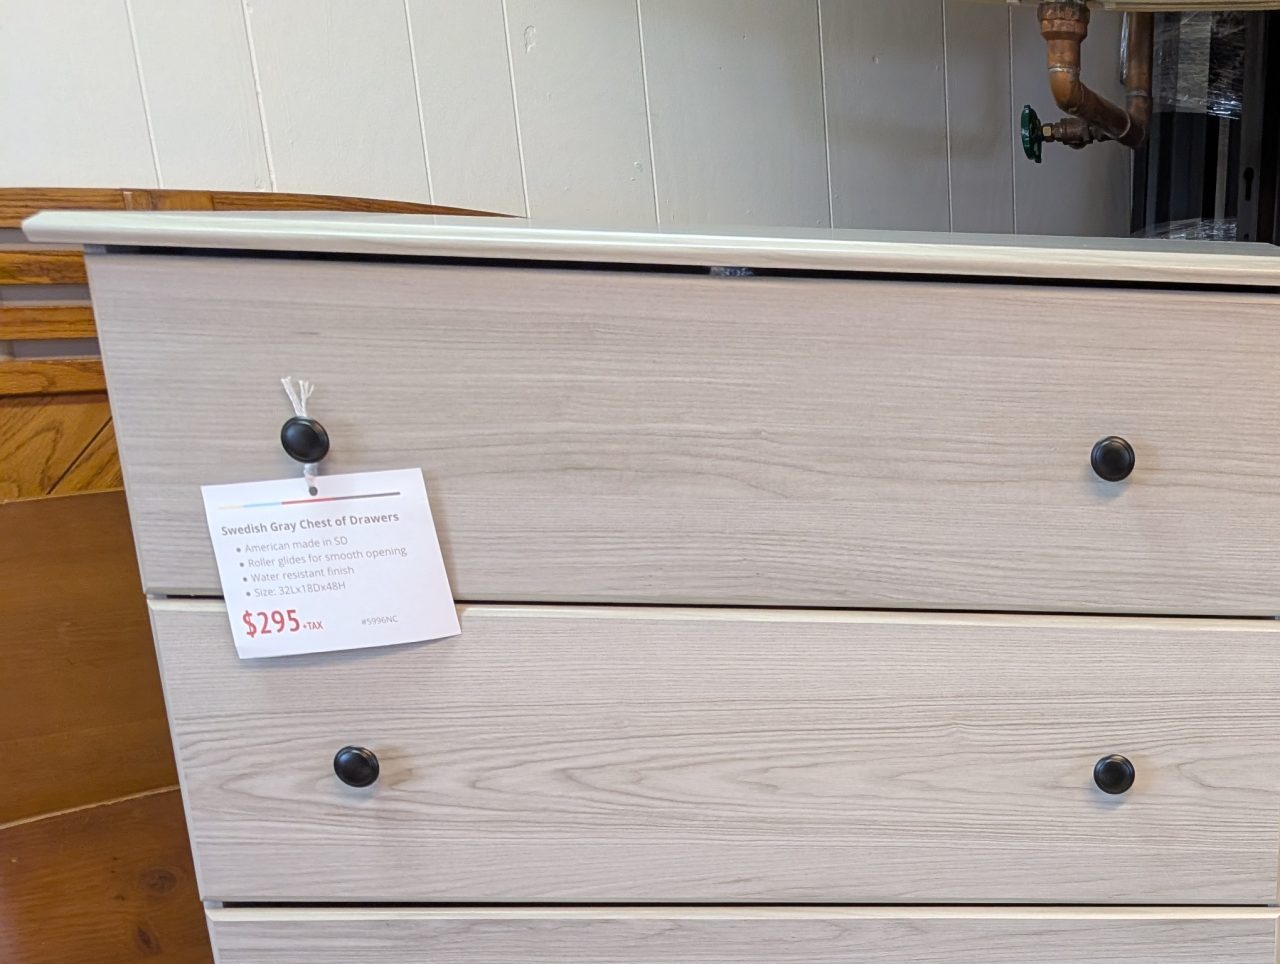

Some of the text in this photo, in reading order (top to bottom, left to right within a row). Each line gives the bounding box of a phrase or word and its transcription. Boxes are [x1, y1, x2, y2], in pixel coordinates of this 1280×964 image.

[221, 512, 399, 536] Swedish Gray Chest of Drawers
[245, 536, 348, 552] American made in SD
[248, 546, 407, 569] Roller glides for smooth opening
[251, 565, 354, 583] Water resistant finish
[255, 581, 346, 598] Size: 32Lx18Dx48H
[242, 609, 323, 638] $295 +TAX
